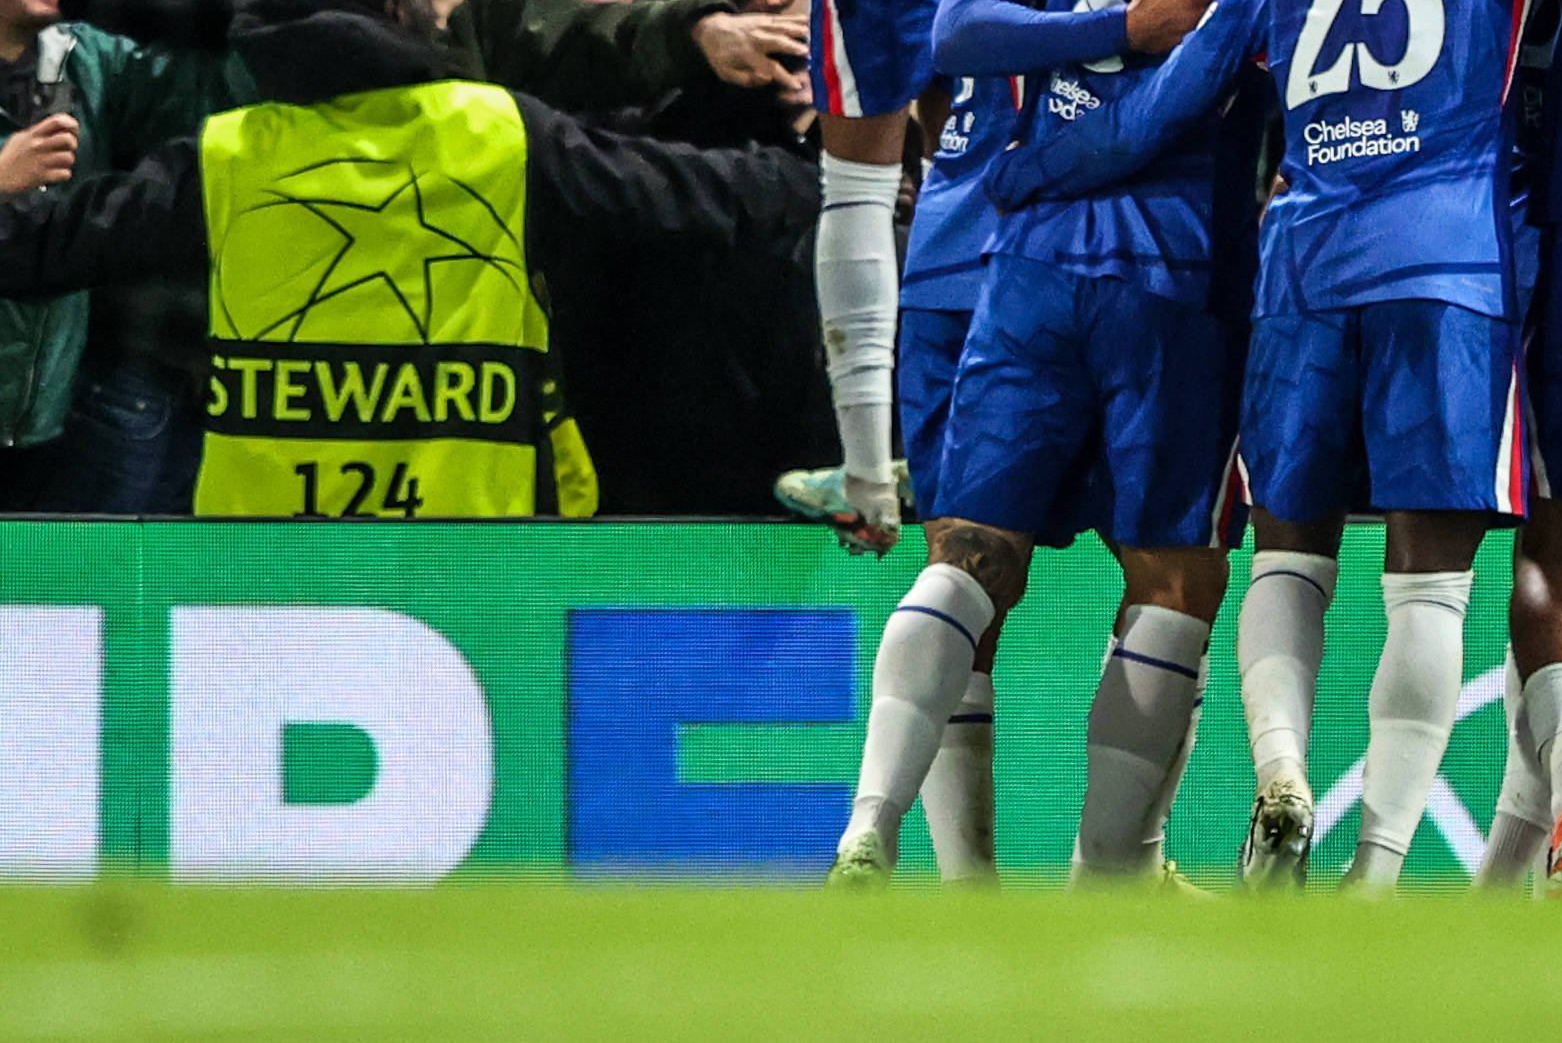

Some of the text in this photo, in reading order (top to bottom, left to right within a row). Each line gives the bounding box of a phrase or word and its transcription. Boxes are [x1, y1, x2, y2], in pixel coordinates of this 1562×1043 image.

[1303, 115, 1388, 147] Chelsea
[1307, 134, 1421, 167] Foundation
[206, 353, 518, 424] STEWARD
[293, 460, 425, 518] 124
